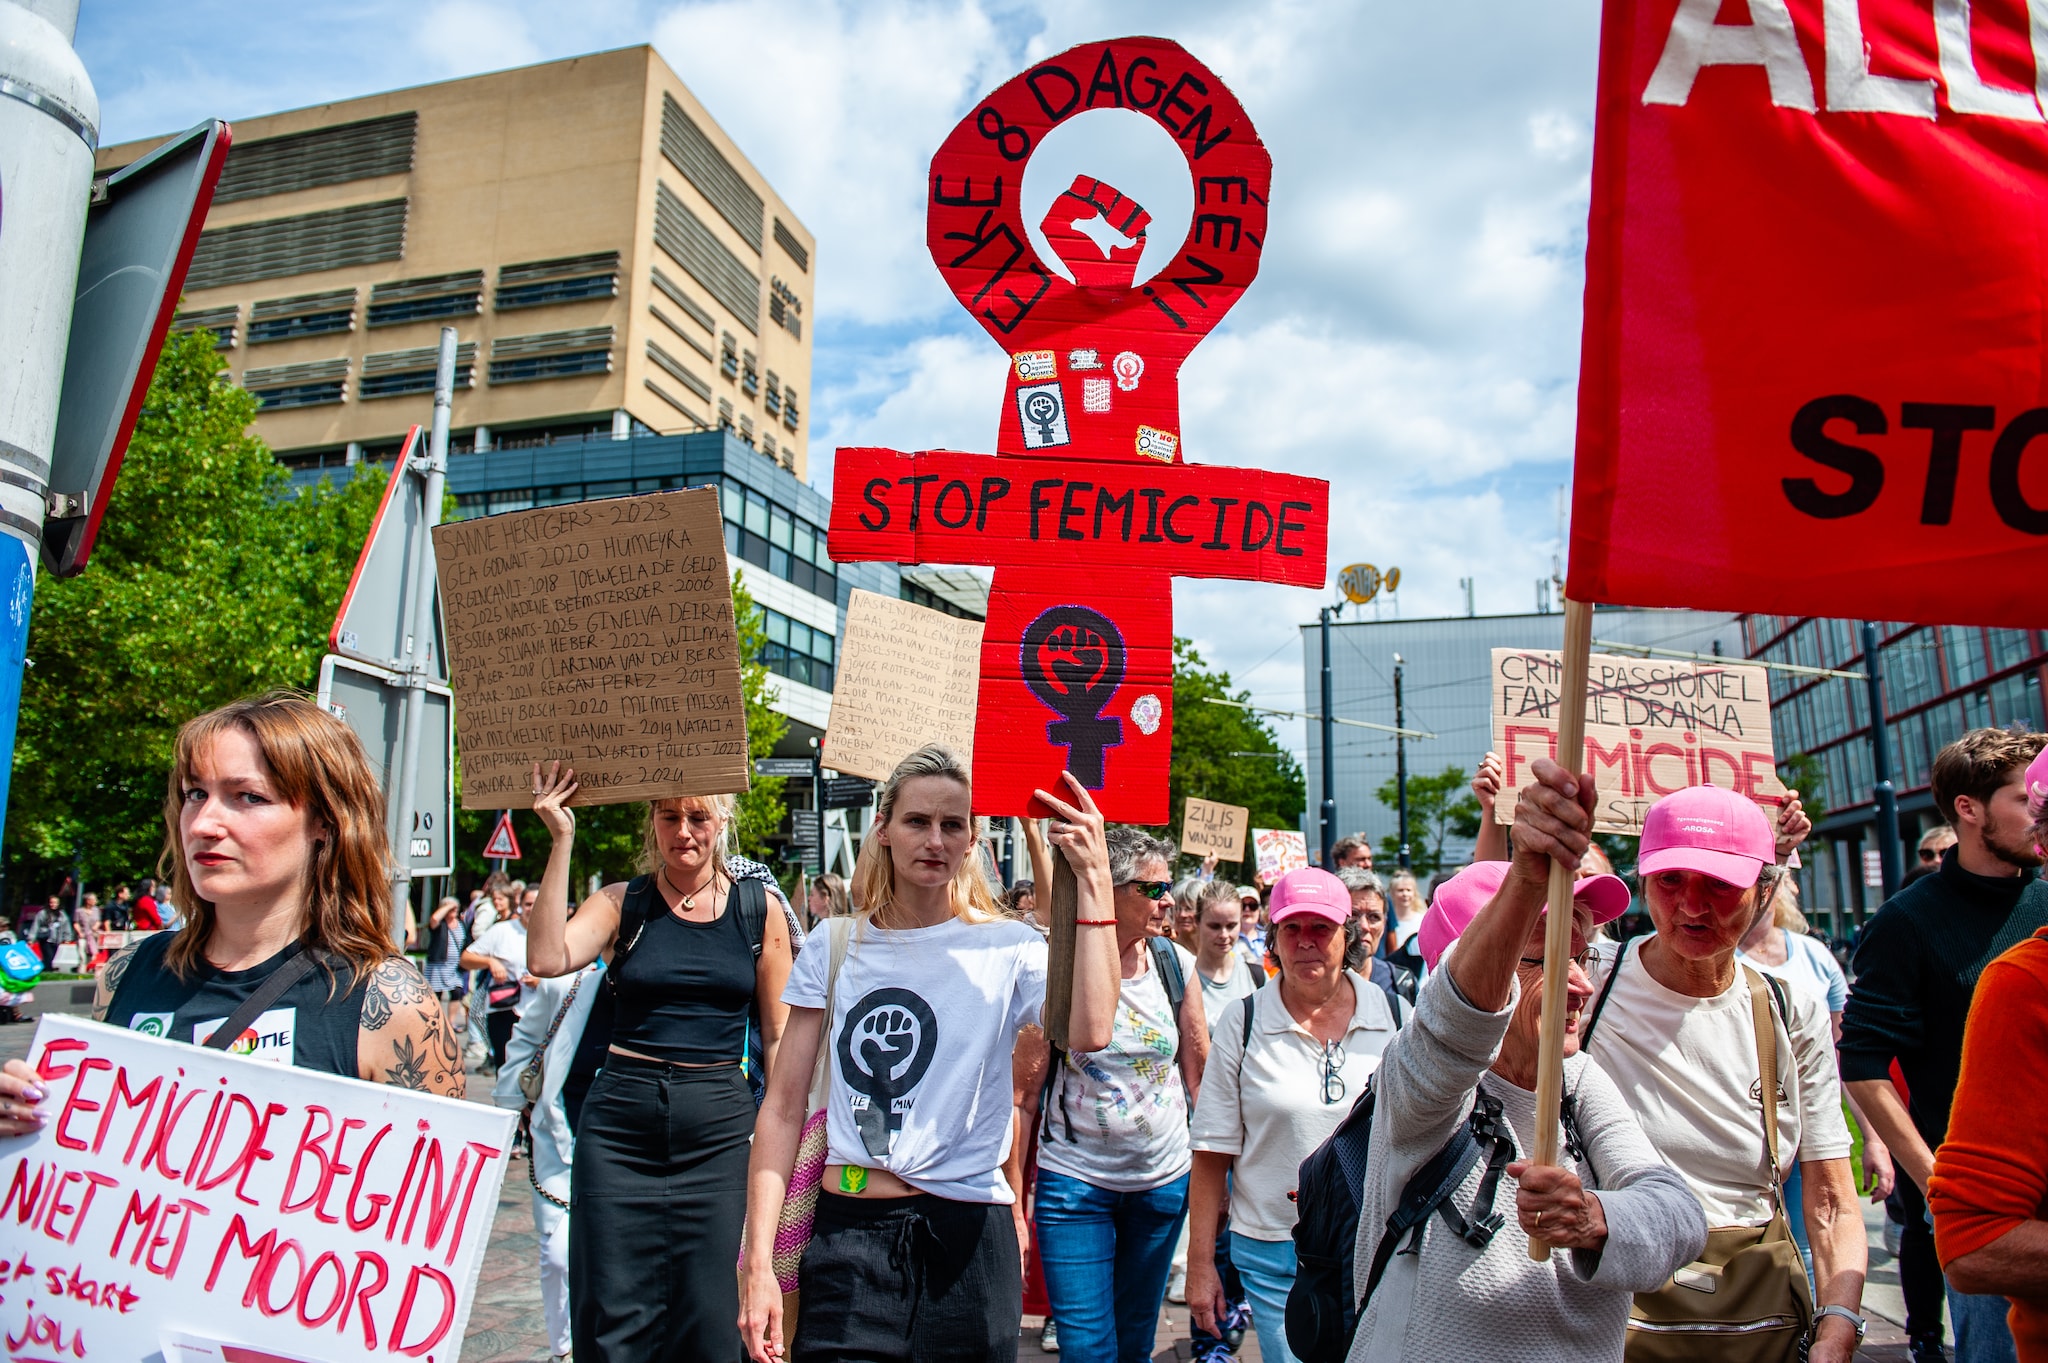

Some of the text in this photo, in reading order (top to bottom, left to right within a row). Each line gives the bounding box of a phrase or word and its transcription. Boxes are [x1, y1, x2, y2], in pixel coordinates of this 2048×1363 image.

[1641, 0, 2048, 122] ALL
[1026, 46, 1232, 161] DAGEN
[976, 106, 1032, 162] 8
[934, 174, 1053, 334] ELKE
[1140, 428, 1157, 438] SAY
[441, 524, 498, 561] SANNE
[501, 508, 593, 549] HERTGERS
[610, 501, 671, 525] 2023
[859, 475, 1312, 557] STOP FEMICIDE
[445, 561, 478, 591] GEA
[651, 559, 675, 576] DE
[467, 607, 502, 629] 2025
[505, 600, 549, 621] NADINE
[855, 595, 912, 618] NASRIN
[450, 630, 496, 659] JESSICA
[586, 604, 663, 633] GINELVA
[669, 602, 728, 624] DEIRA
[498, 639, 545, 664] SILVANA
[609, 632, 655, 650] 2022
[663, 626, 729, 647] WILMA
[850, 627, 908, 649] MIRANDA
[906, 639, 926, 652] VAN
[894, 621, 918, 637] 2024
[924, 627, 961, 652] LENNY
[455, 676, 467, 690] DE
[541, 655, 616, 680] CLARINDA
[619, 651, 645, 671] VAN
[651, 650, 679, 667] DEN
[541, 677, 594, 697] REAGAN
[602, 673, 658, 693] PEREZ
[674, 666, 716, 688] 2019
[844, 658, 878, 675] JOYCE
[945, 664, 972, 679] LARA
[458, 706, 514, 733] SHELLEY
[567, 698, 608, 716] 2020
[621, 695, 680, 718] MIMIE
[841, 687, 868, 698] 2018
[876, 691, 934, 715] MARIJKE
[879, 704, 903, 718] VAN
[460, 732, 483, 752] NOA
[487, 725, 555, 747] MICHELINE
[561, 722, 626, 744] FUANANI
[640, 719, 672, 742] 2019
[677, 717, 734, 736] NATALIA
[833, 723, 863, 736] 2023
[464, 751, 530, 779] KEMPINSKA
[543, 748, 574, 763] 2024
[582, 744, 650, 762] INGRID
[830, 749, 862, 765] JANE
[831, 736, 874, 750] HOEBEN
[884, 745, 909, 758] 202
[468, 775, 514, 797] SANDRA
[638, 767, 684, 784] 2024
[1189, 806, 1234, 827] ZIJ IS
[1607, 800, 1650, 831] ST
[1188, 831, 1233, 849] VAN JOU
[0, 1156, 121, 1246] NIET
[110, 1188, 211, 1281] MET
[5, 1298, 87, 1358] jou
